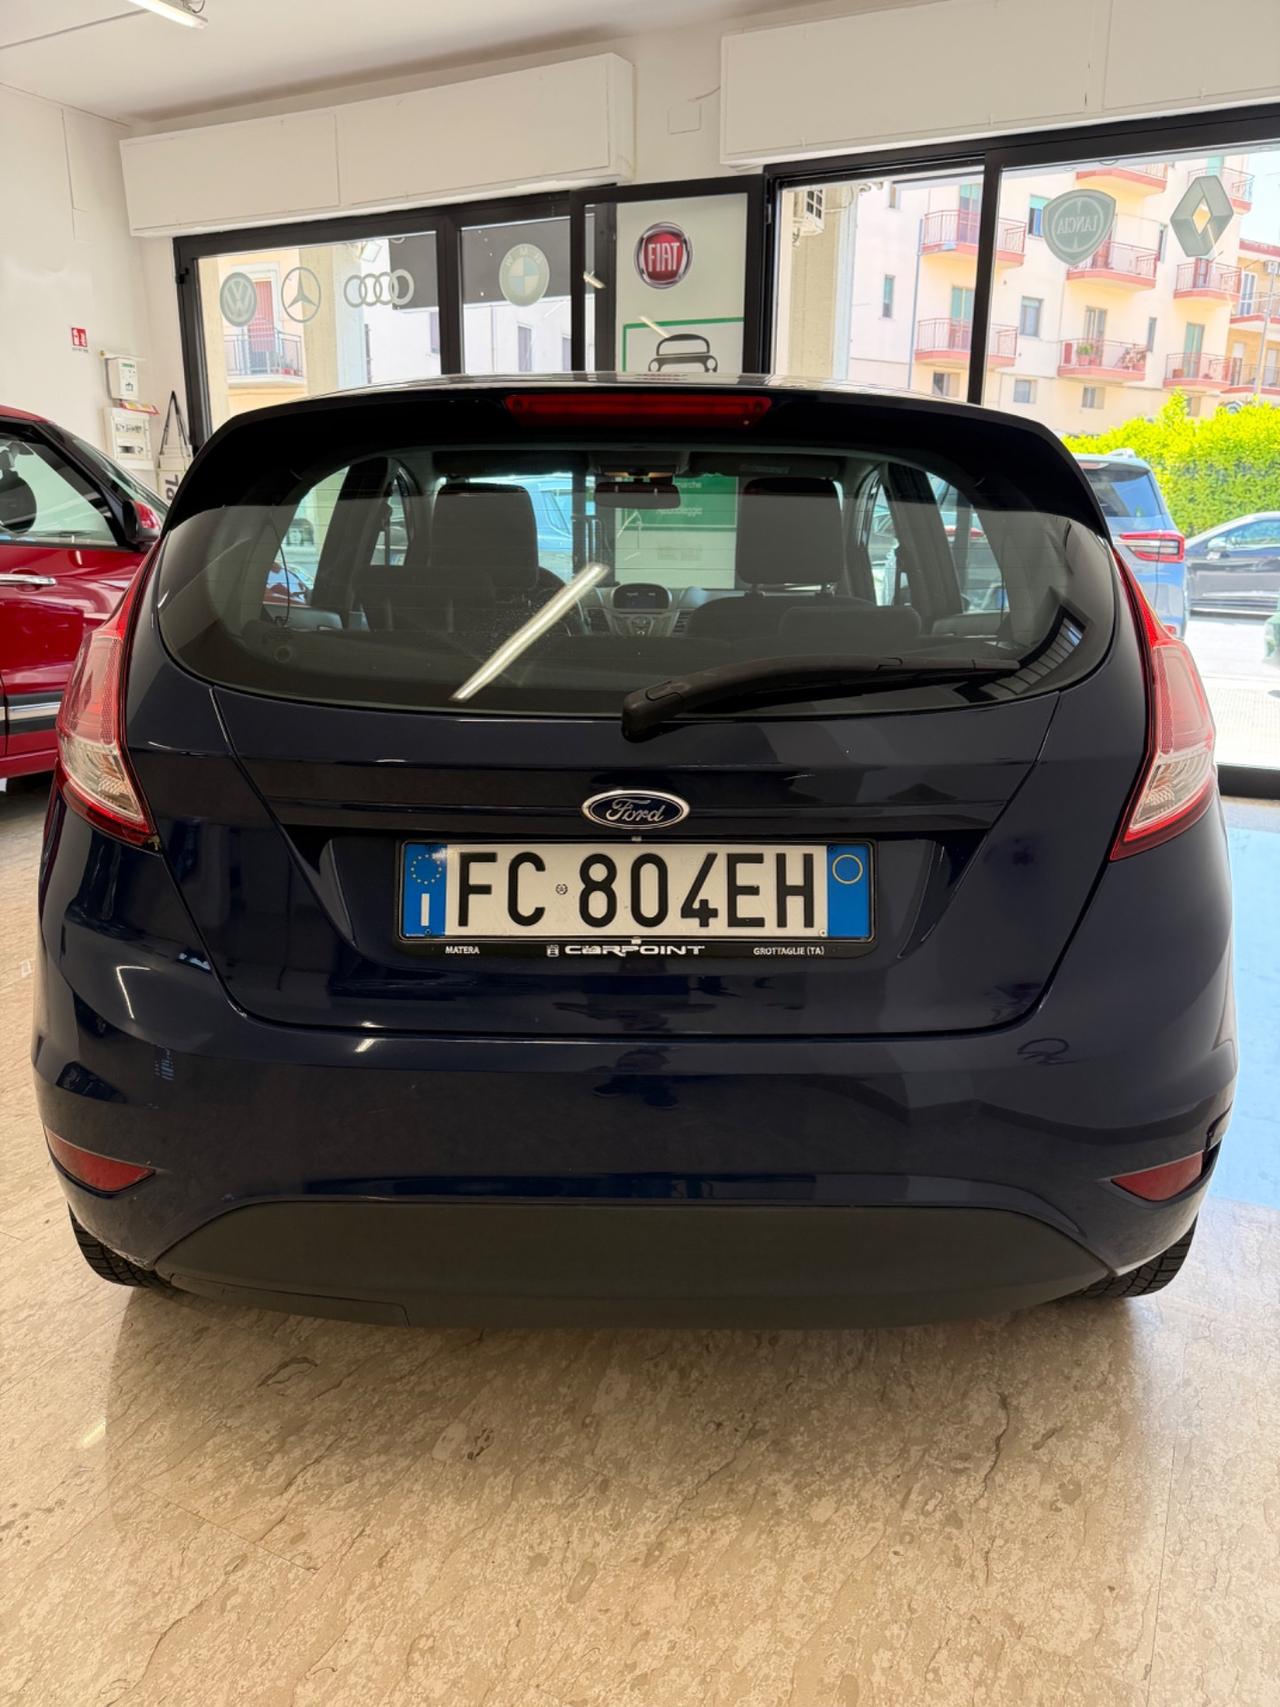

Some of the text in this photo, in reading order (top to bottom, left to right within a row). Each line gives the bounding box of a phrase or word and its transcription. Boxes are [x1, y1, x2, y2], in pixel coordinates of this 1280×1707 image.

[647, 242, 680, 272] FIAT
[605, 798, 666, 822] Ford
[445, 945, 480, 955] MATERA
[753, 946, 825, 957] GROTTAGLIE (TA)
